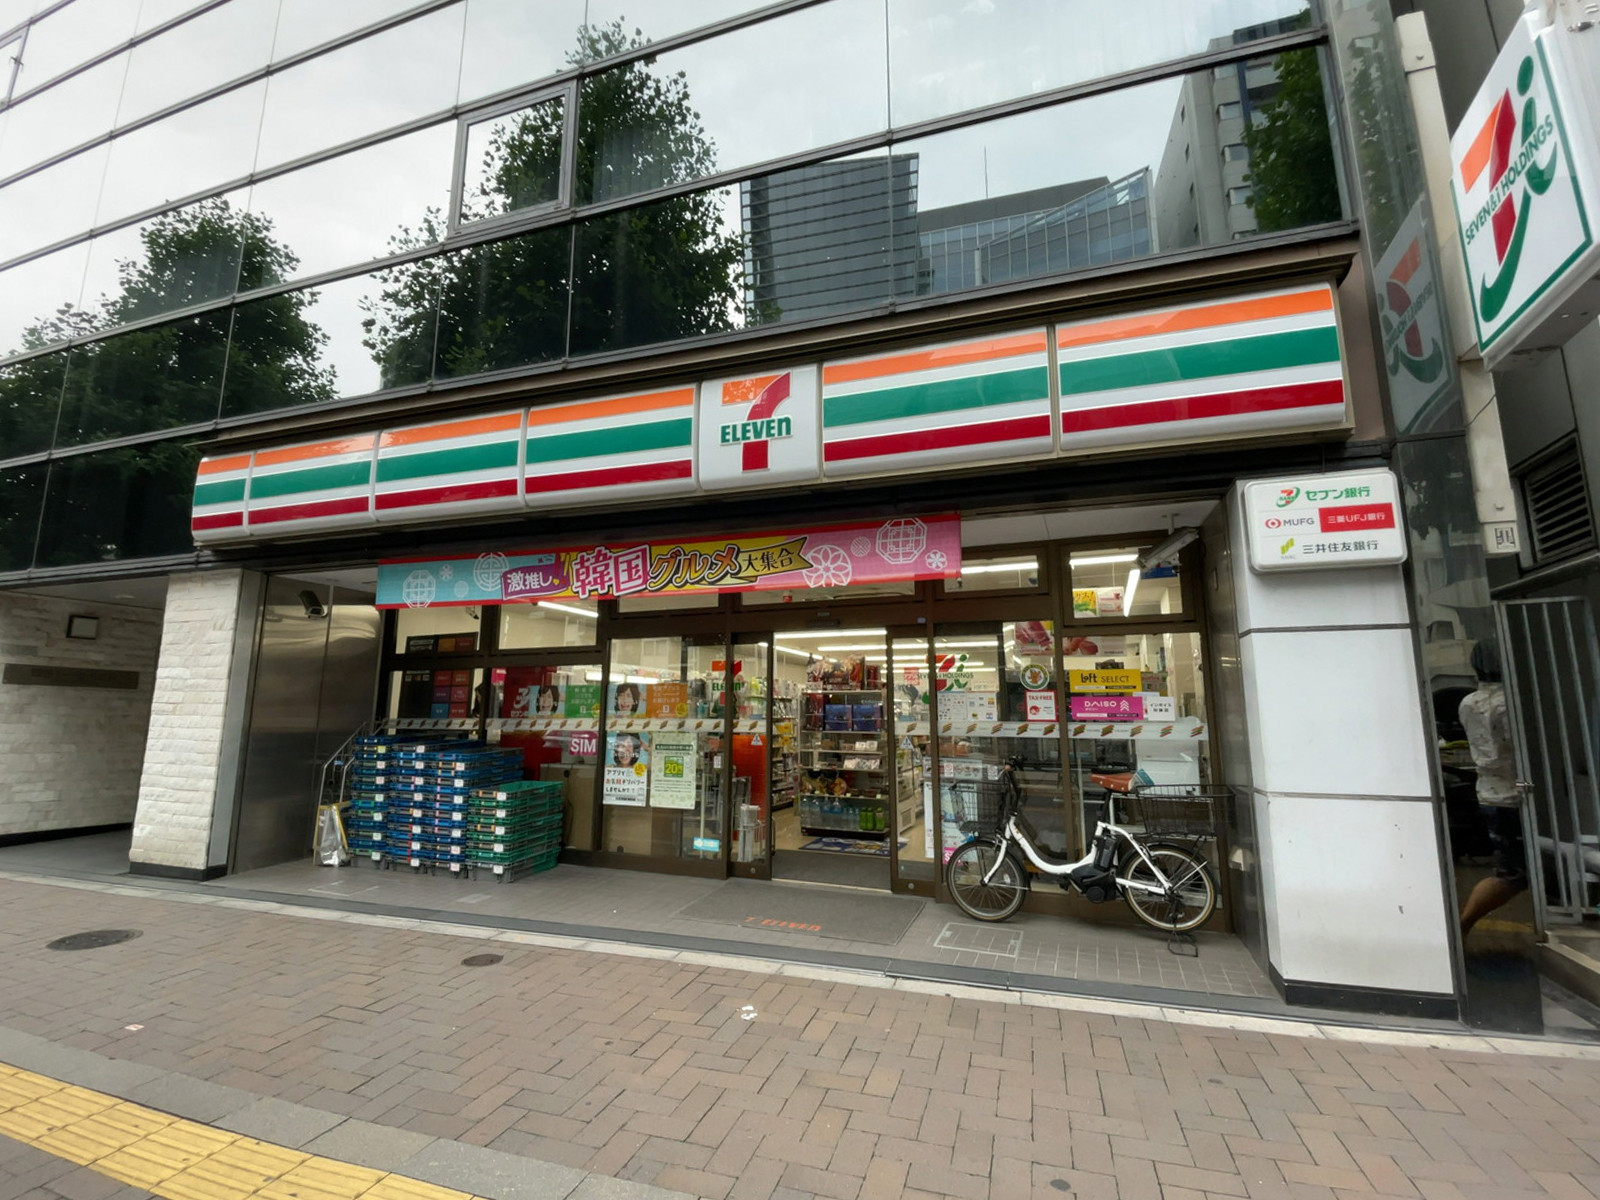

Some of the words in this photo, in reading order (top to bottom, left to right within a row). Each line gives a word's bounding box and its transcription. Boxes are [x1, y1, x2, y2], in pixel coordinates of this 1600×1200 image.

[1500, 114, 1554, 196] HOLDINGS
[1305, 486, 1371, 501] セブン銀行
[1284, 518, 1314, 526] MUFG
[1328, 513, 1385, 523] 三菱UFJ銀行
[1302, 539, 1380, 555] 三井住友銀行
[942, 672, 974, 680] HOLDINGS
[1101, 675, 1130, 683] SELECT
[1084, 700, 1117, 708] DAISO
[570, 738, 597, 753] SIM
